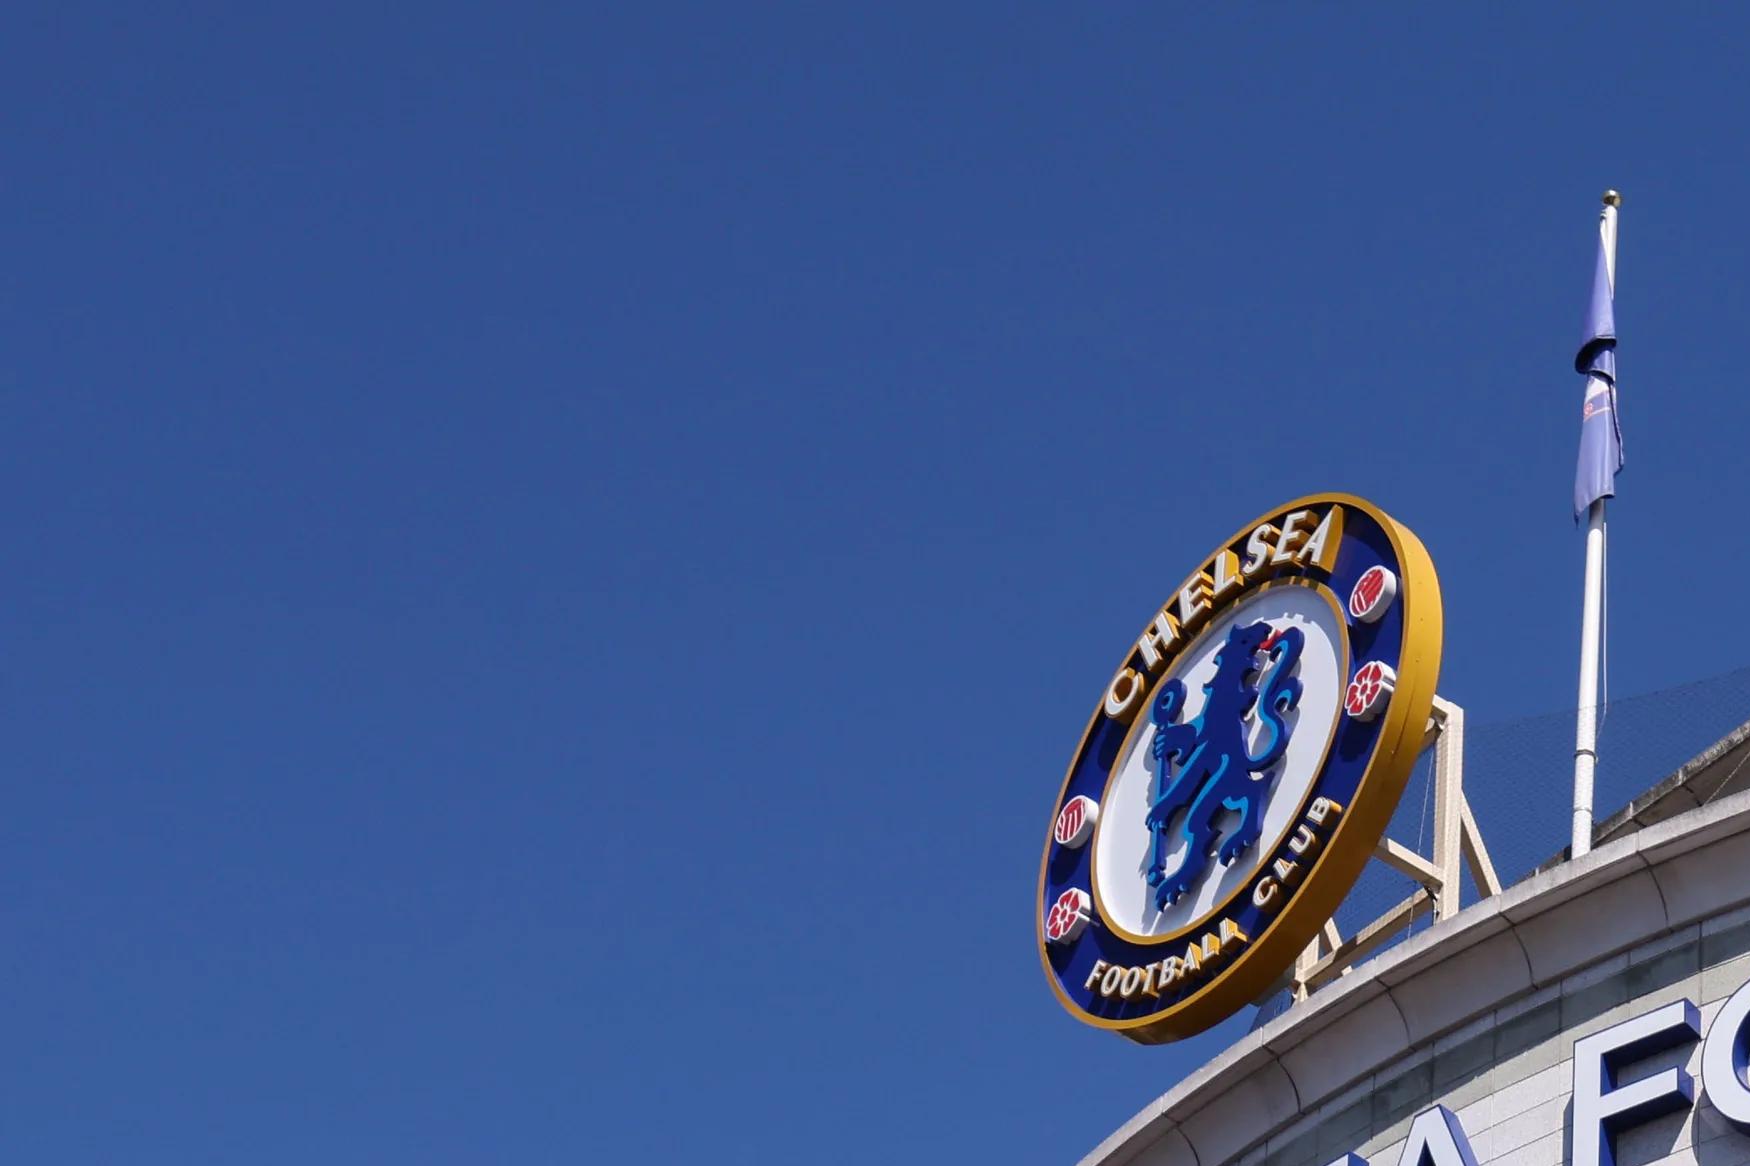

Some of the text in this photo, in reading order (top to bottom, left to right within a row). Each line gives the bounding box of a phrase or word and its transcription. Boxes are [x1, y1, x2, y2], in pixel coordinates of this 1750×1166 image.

[1103, 504, 1344, 722] CHELSEA
[1084, 796, 1342, 998] FOOTBALL CLUB
